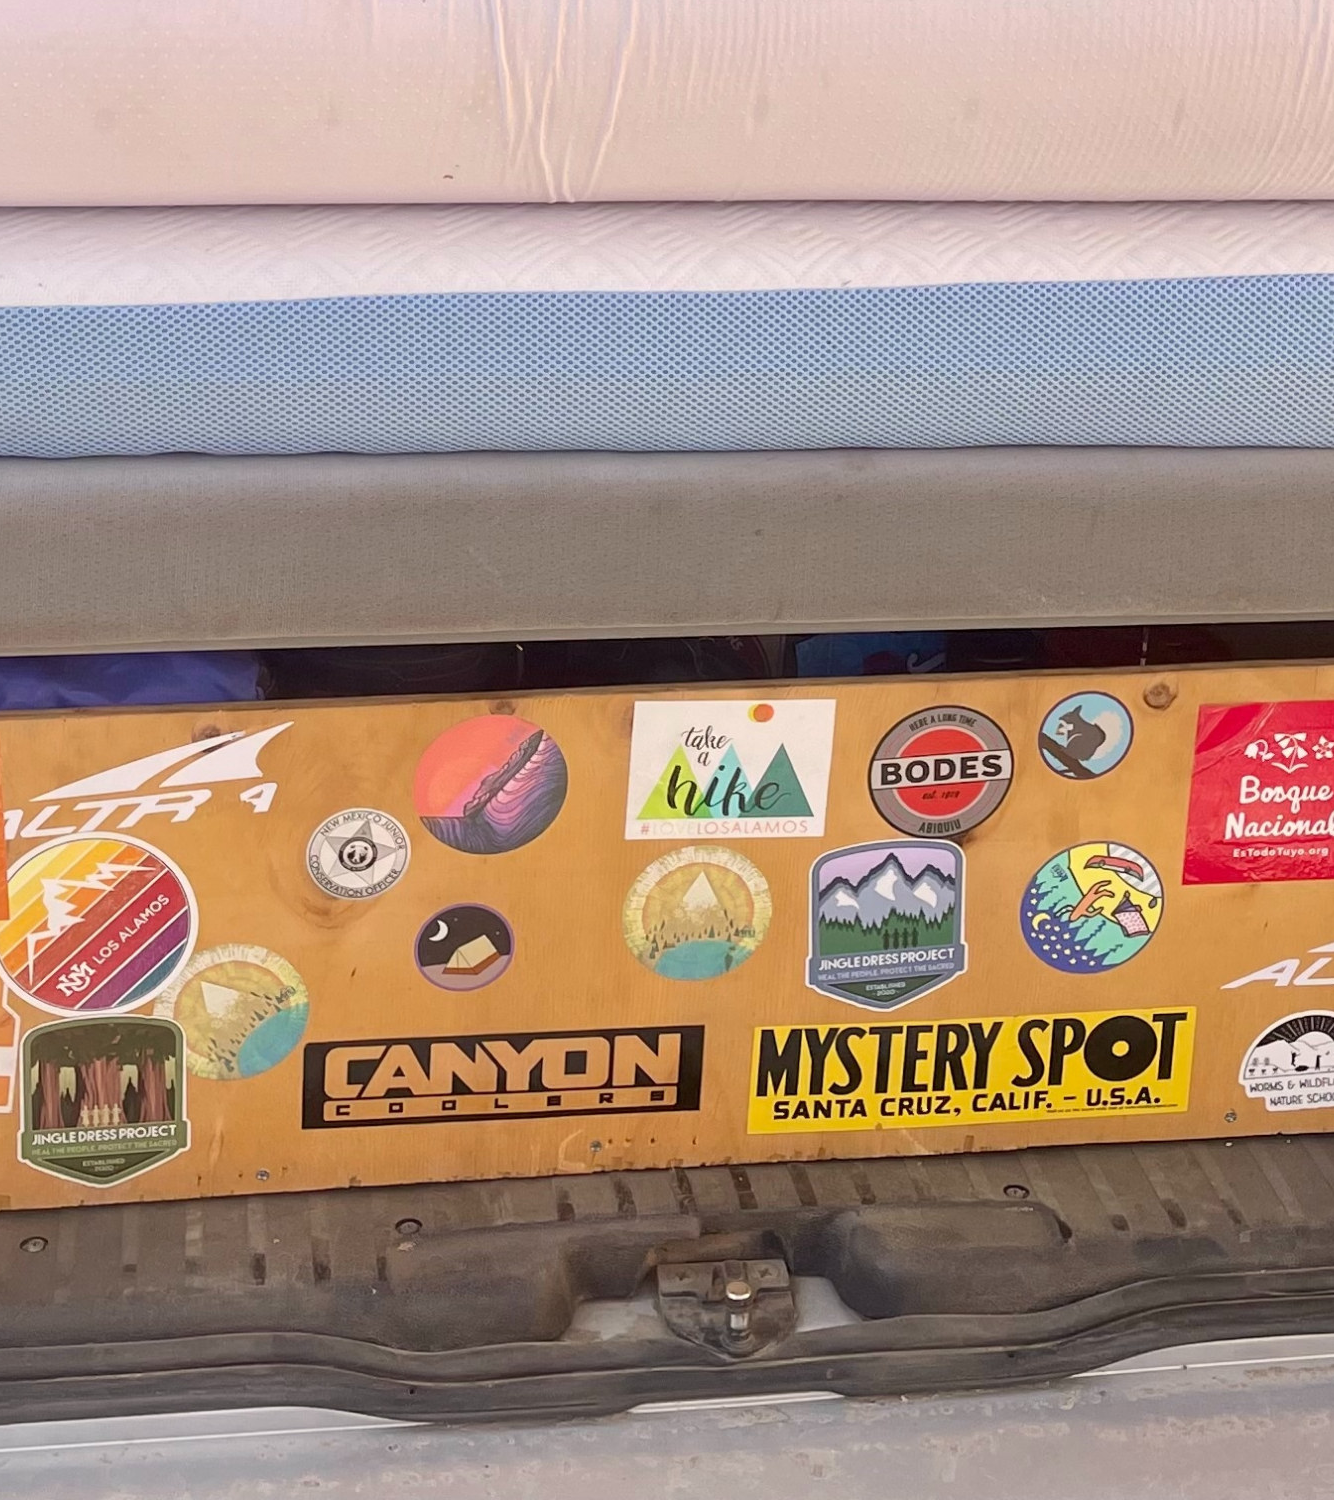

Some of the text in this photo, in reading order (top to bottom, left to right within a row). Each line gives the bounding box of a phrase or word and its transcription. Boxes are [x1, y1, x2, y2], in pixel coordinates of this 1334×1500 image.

[909, 713, 977, 731] HERE A LONG TIME
[681, 725, 734, 750] take
[697, 750, 711, 767] a
[880, 754, 1002, 786] BODES
[667, 765, 791, 816] hike
[1239, 775, 1334, 814] Bosque
[320, 812, 405, 850] NEW MEXICO JUNIOR
[917, 818, 962, 834] ABIQUIU
[310, 854, 400, 897] CONSERVATION OFFICER
[92, 940, 120, 965] LOS
[118, 894, 170, 943] ALAMOS
[818, 948, 955, 971] JINGLE DRESS PROJECT
[880, 966, 913, 975] PROTECT
[324, 1033, 681, 1100] CANYON
[756, 1012, 1188, 1097] MYSTERY SPOT
[1250, 1081, 1284, 1093] WORMS
[1287, 1080, 1296, 1090] &
[335, 1089, 666, 1117] COOLERS
[773, 1098, 868, 1121] SANTA
[879, 1095, 962, 1117] CRUZ,
[972, 1089, 1053, 1112] CALIF.
[1086, 1086, 1161, 1107] U.S.A.
[1270, 1094, 1304, 1106] NATURE
[32, 1124, 177, 1146] JINGLE DRESS PROJECT
[52, 1146, 65, 1154] THE
[133, 1140, 147, 1148] THE
